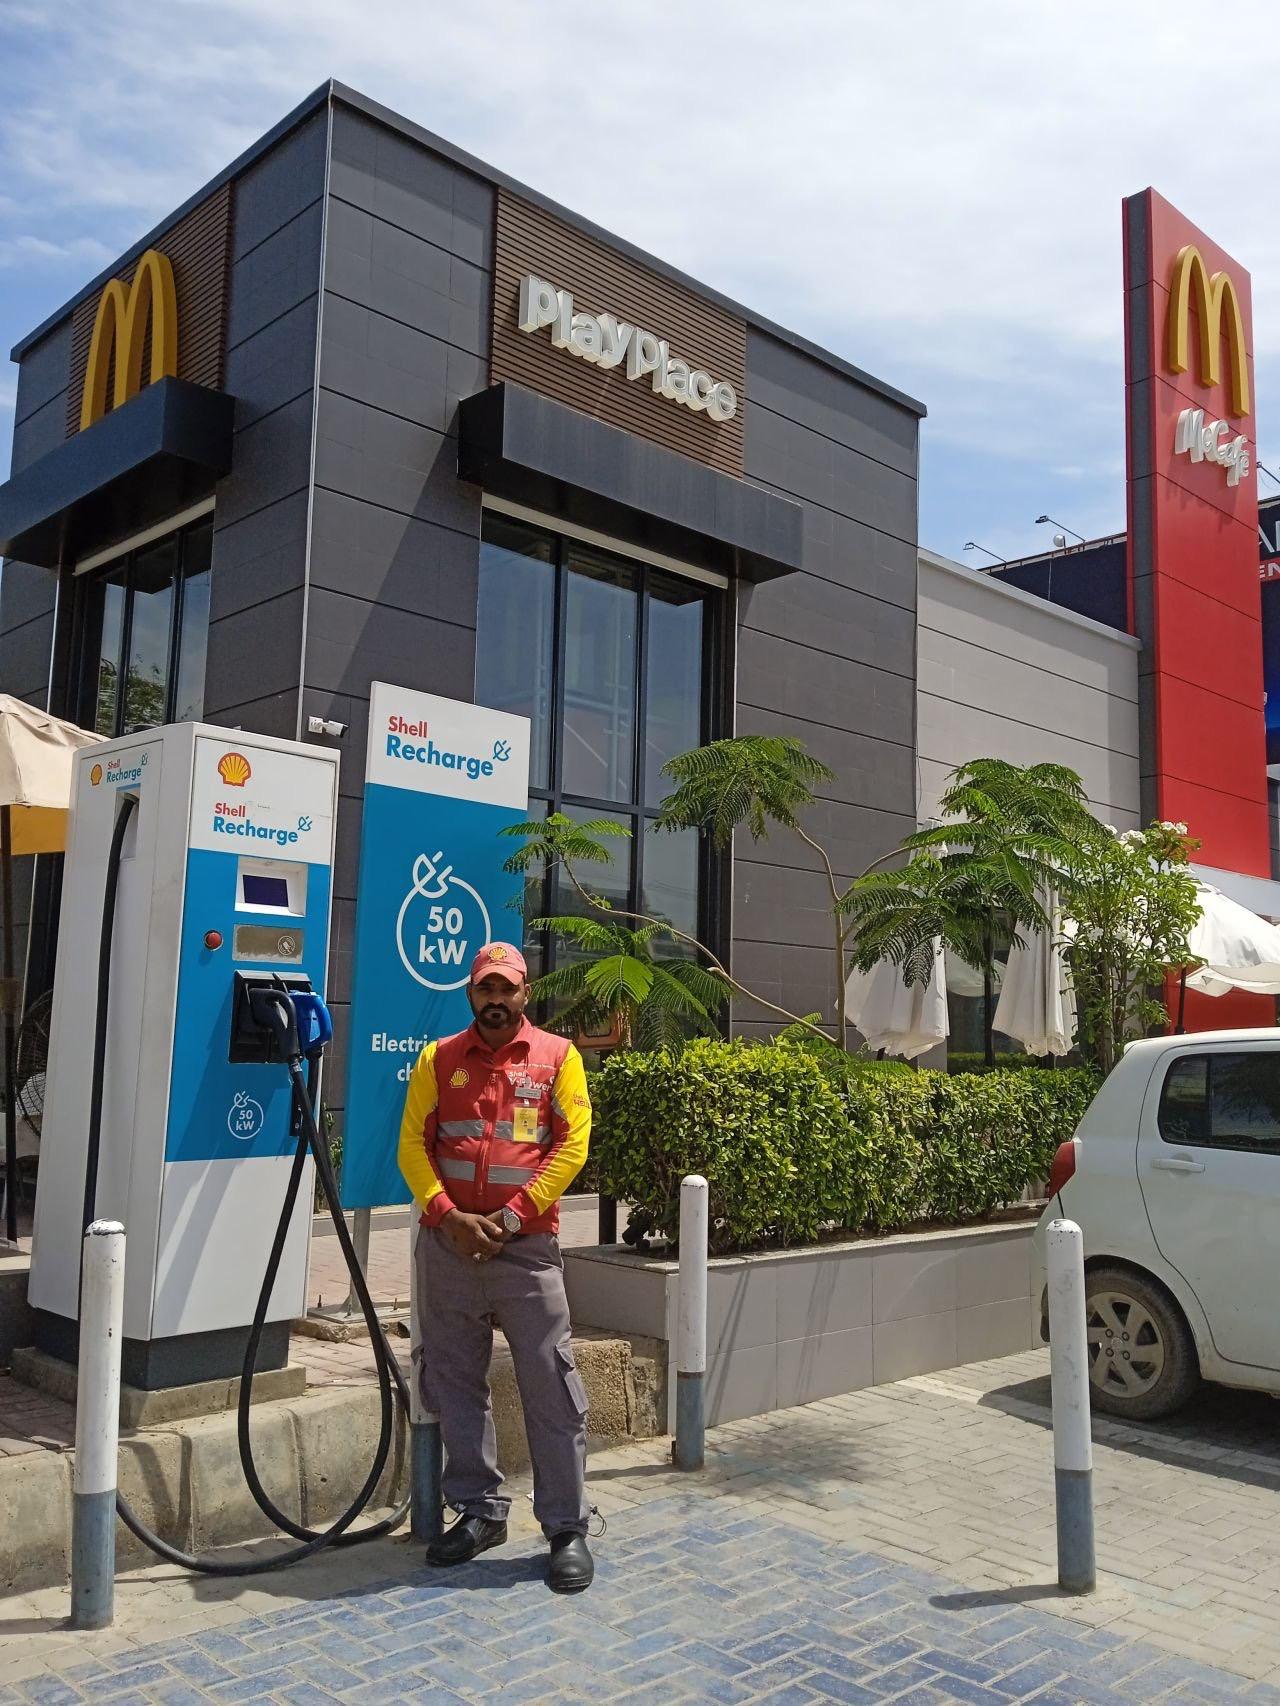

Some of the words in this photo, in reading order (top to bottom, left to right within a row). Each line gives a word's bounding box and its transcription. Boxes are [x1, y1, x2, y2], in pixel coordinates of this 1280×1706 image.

[388, 715, 428, 738] Shell
[107, 759, 120, 770] Shell
[386, 734, 494, 780] Recharge
[106, 768, 142, 783] Recharge
[214, 802, 246, 817] Shell
[213, 815, 299, 846] Recharge
[427, 905, 464, 935] 50
[419, 934, 468, 965] kW
[371, 1032, 428, 1053] Electri
[239, 1109, 254, 1120] 50
[235, 1120, 255, 1131] kW
